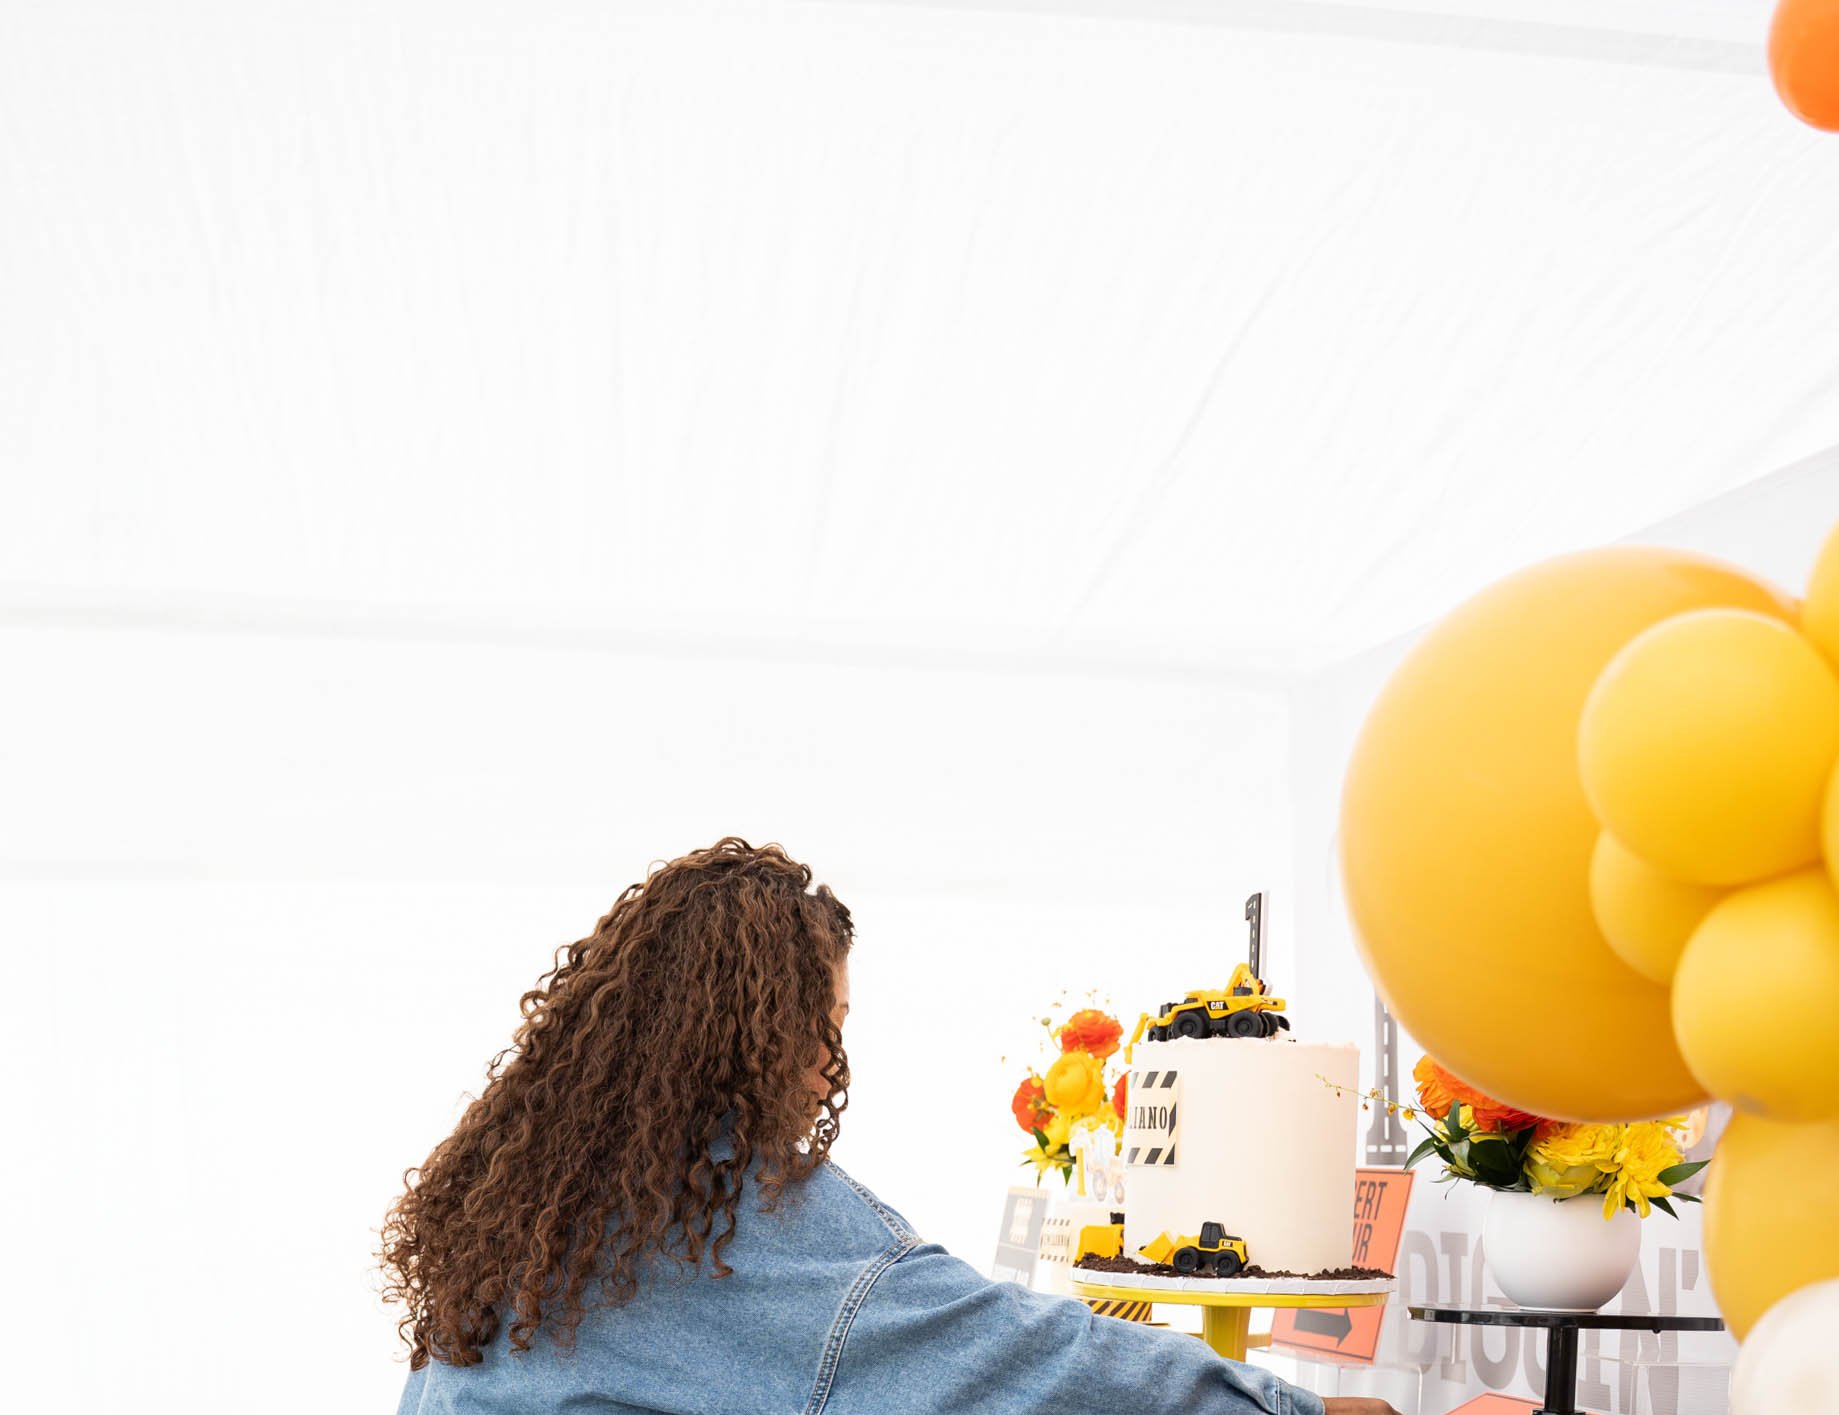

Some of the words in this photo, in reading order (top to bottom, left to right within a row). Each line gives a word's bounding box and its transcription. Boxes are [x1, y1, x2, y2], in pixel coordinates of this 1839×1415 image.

[1210, 1001, 1225, 1010] CAT
[1354, 1180, 1388, 1221] ERT
[1352, 1223, 1373, 1263] UR
